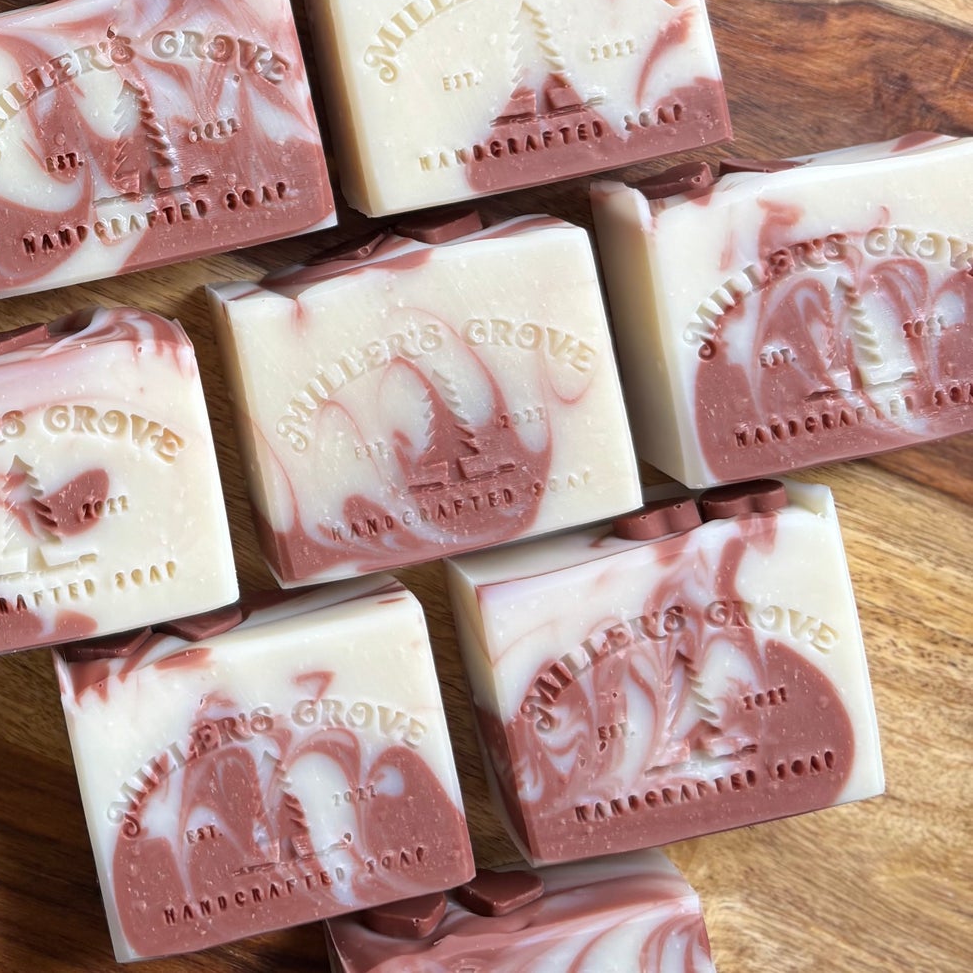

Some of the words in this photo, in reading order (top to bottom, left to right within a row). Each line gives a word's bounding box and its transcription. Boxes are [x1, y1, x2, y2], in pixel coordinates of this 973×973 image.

[151, 30, 290, 84] GROVE
[443, 73, 480, 91] EST.
[46, 153, 83, 172] EST.
[419, 121, 603, 171] HANDCRAFTED
[624, 104, 684, 131] SOAP
[23, 199, 207, 253] HANDCRAFTED
[226, 182, 288, 210] SOAP
[863, 227, 973, 277] GROV
[276, 325, 445, 454] MILLER'S
[463, 319, 598, 374] GROVE
[43, 405, 185, 464] GROVE
[499, 407, 546, 427] 2022
[734, 395, 914, 446] HANDCRAFED
[331, 489, 513, 541] HANDCRAFTED
[115, 562, 177, 588] SOAP
[521, 606, 686, 732] MILLER'S
[705, 601, 840, 654] GROVE
[107, 707, 274, 840] MILLER'S
[291, 699, 426, 748] GROVE
[575, 770, 756, 822] HANDCRAFTED
[776, 751, 834, 780] SOAP
[187, 826, 222, 844] EST.
[332, 785, 377, 806] 2022
[164, 867, 345, 925] HANDCRAFTED
[365, 847, 426, 873] SOAP
